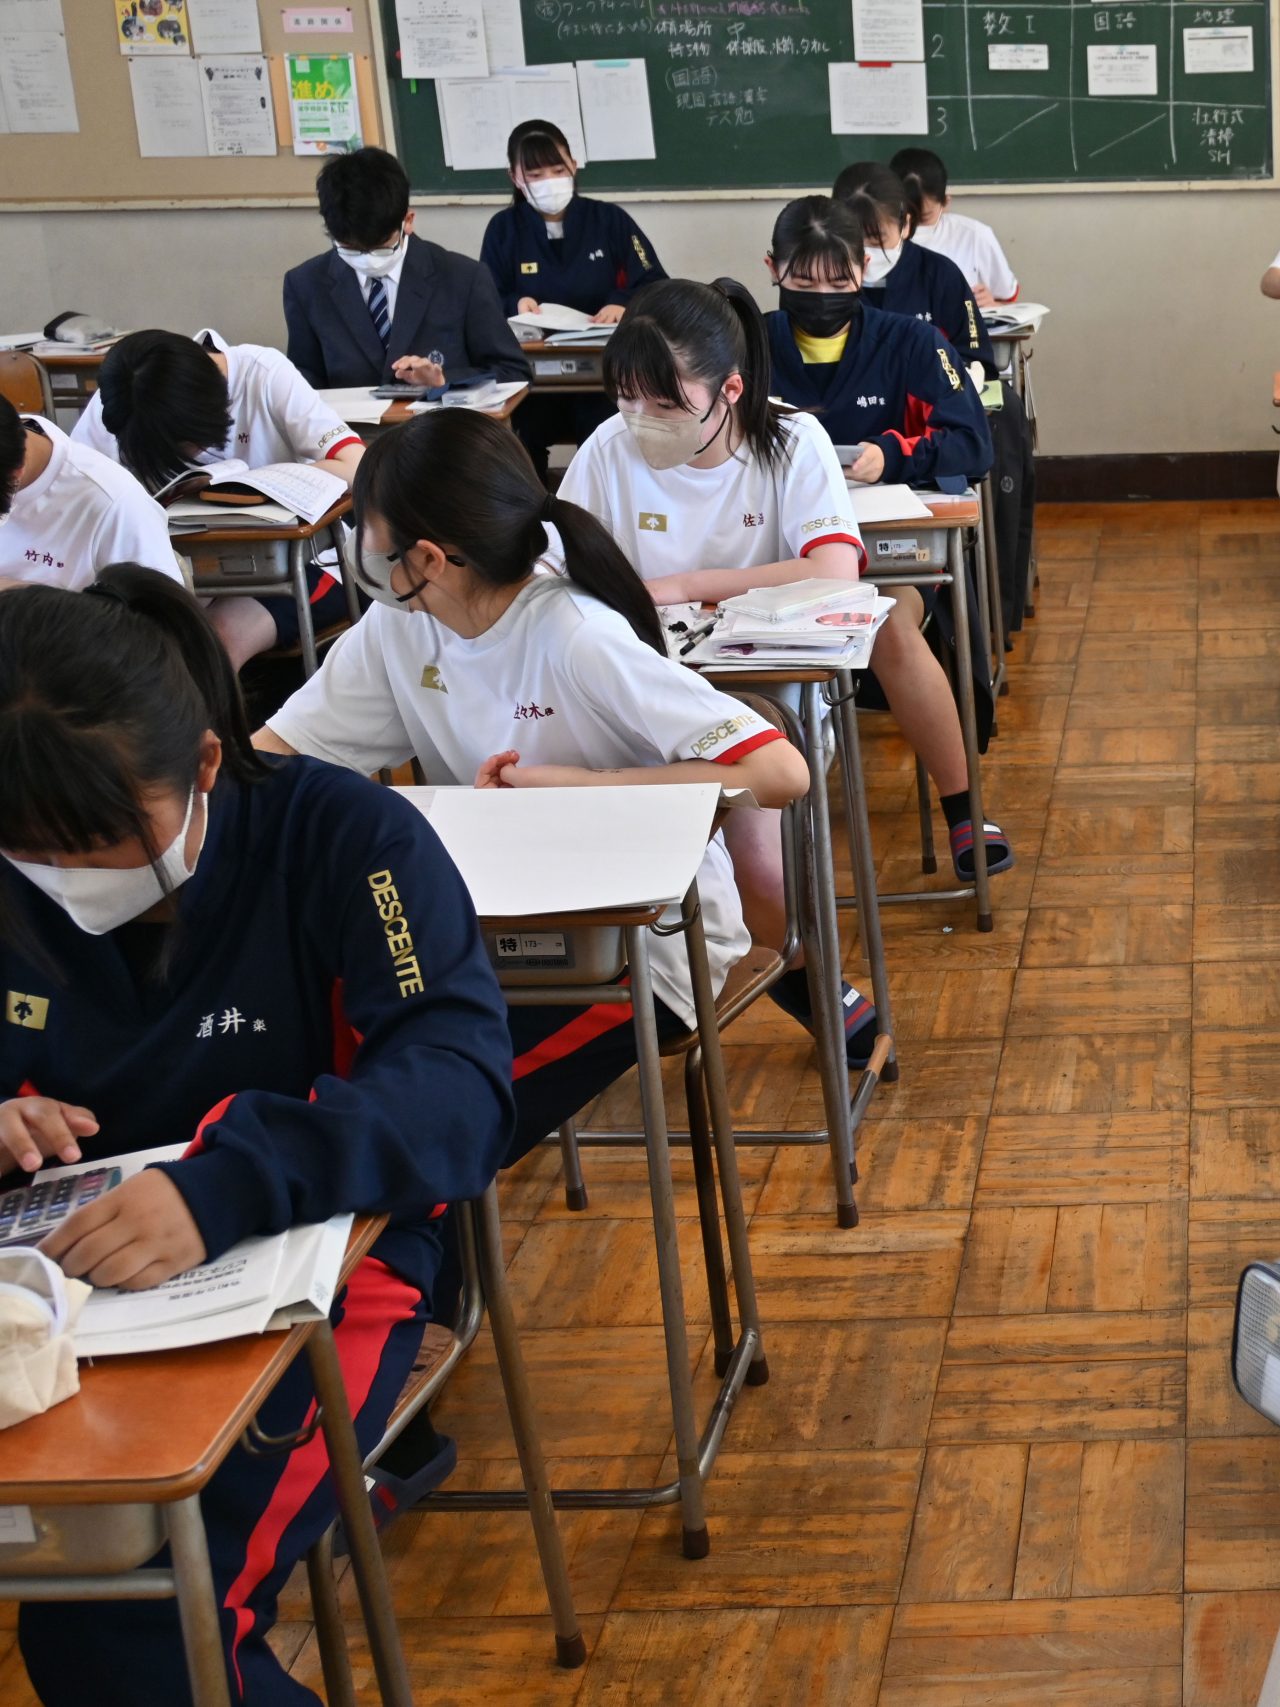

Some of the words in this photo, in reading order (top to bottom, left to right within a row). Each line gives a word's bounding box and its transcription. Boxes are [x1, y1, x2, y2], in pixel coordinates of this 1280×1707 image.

[1094, 11, 1137, 31] 国語
[1194, 8, 1235, 24] 地理
[931, 34, 945, 58] 2
[935, 107, 948, 137] 3
[25, 550, 53, 567] 竹内
[690, 713, 757, 758] DESCENTE
[367, 869, 425, 999] DESCENTE
[500, 938, 519, 953] 特
[196, 1006, 247, 1039] 酒井
